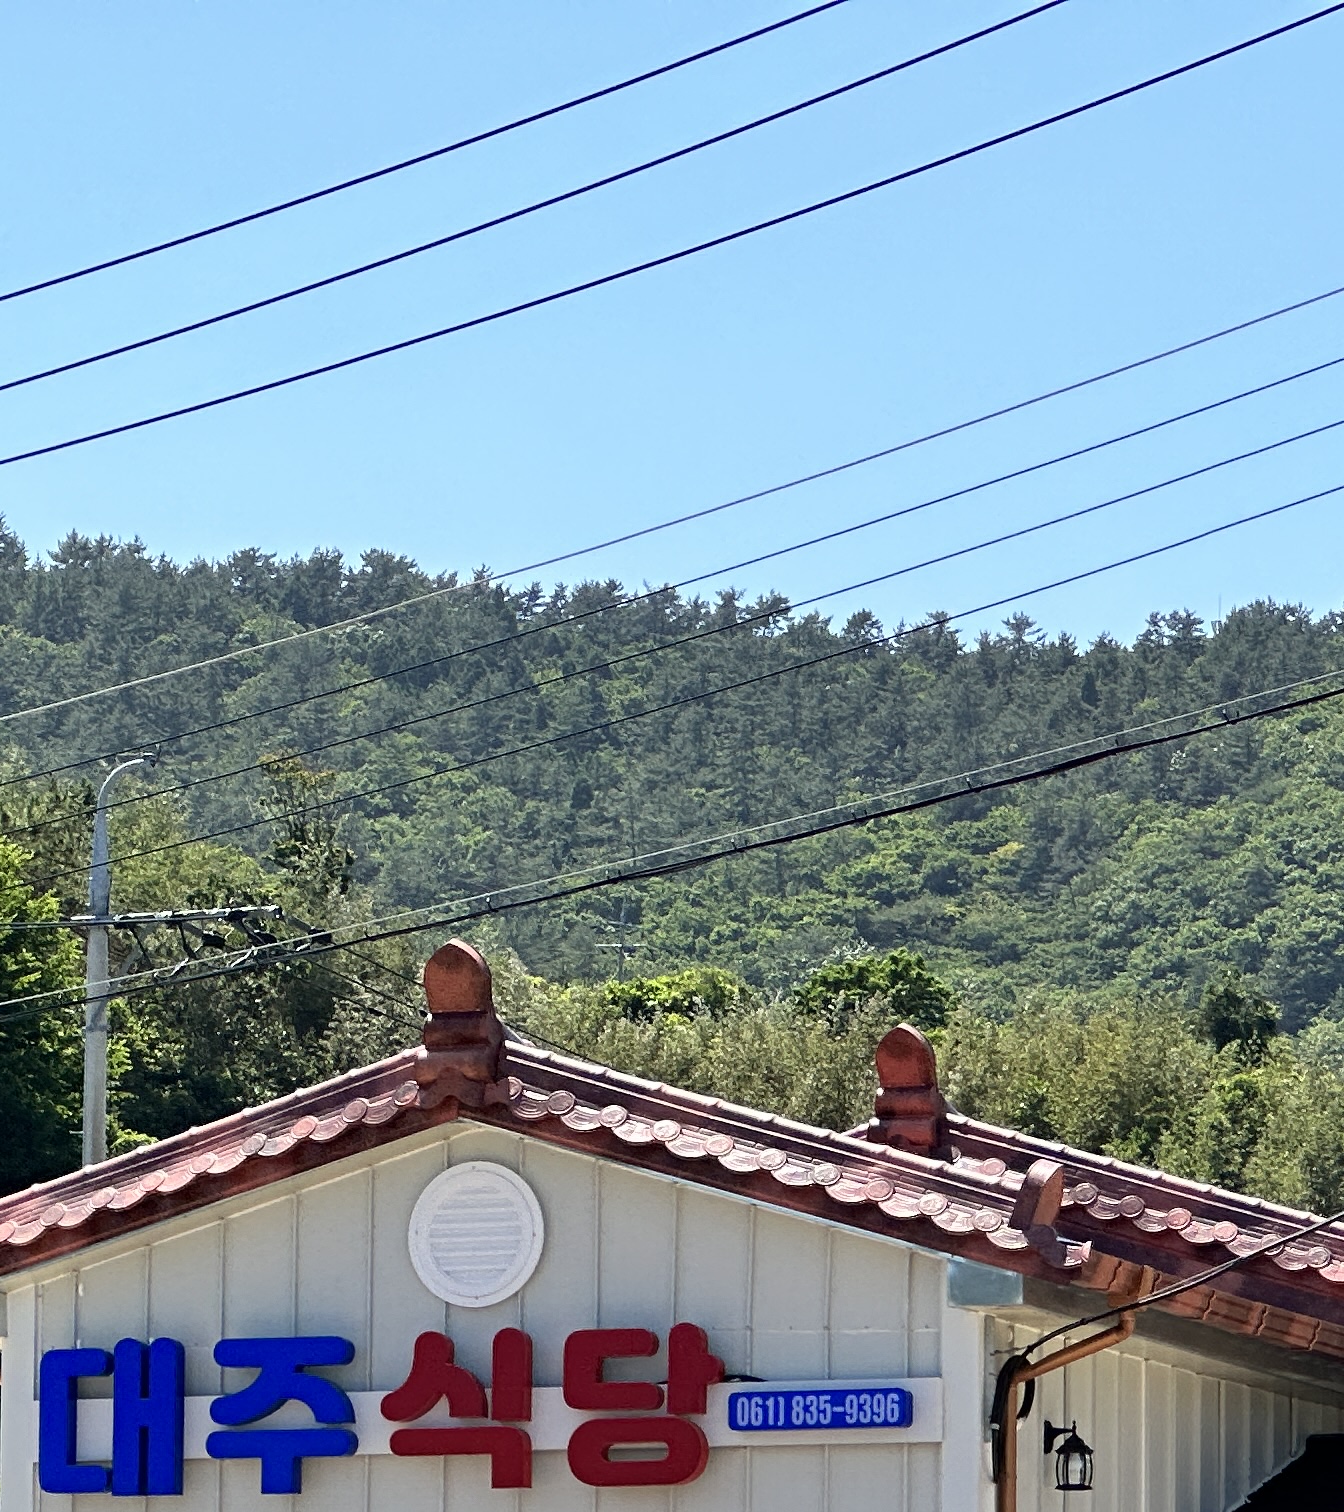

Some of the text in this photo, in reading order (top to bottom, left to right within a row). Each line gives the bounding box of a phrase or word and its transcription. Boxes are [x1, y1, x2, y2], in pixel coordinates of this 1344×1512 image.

[39, 1322, 725, 1496] 대주식당
[736, 1392, 900, 1427] 061) 835-9396
